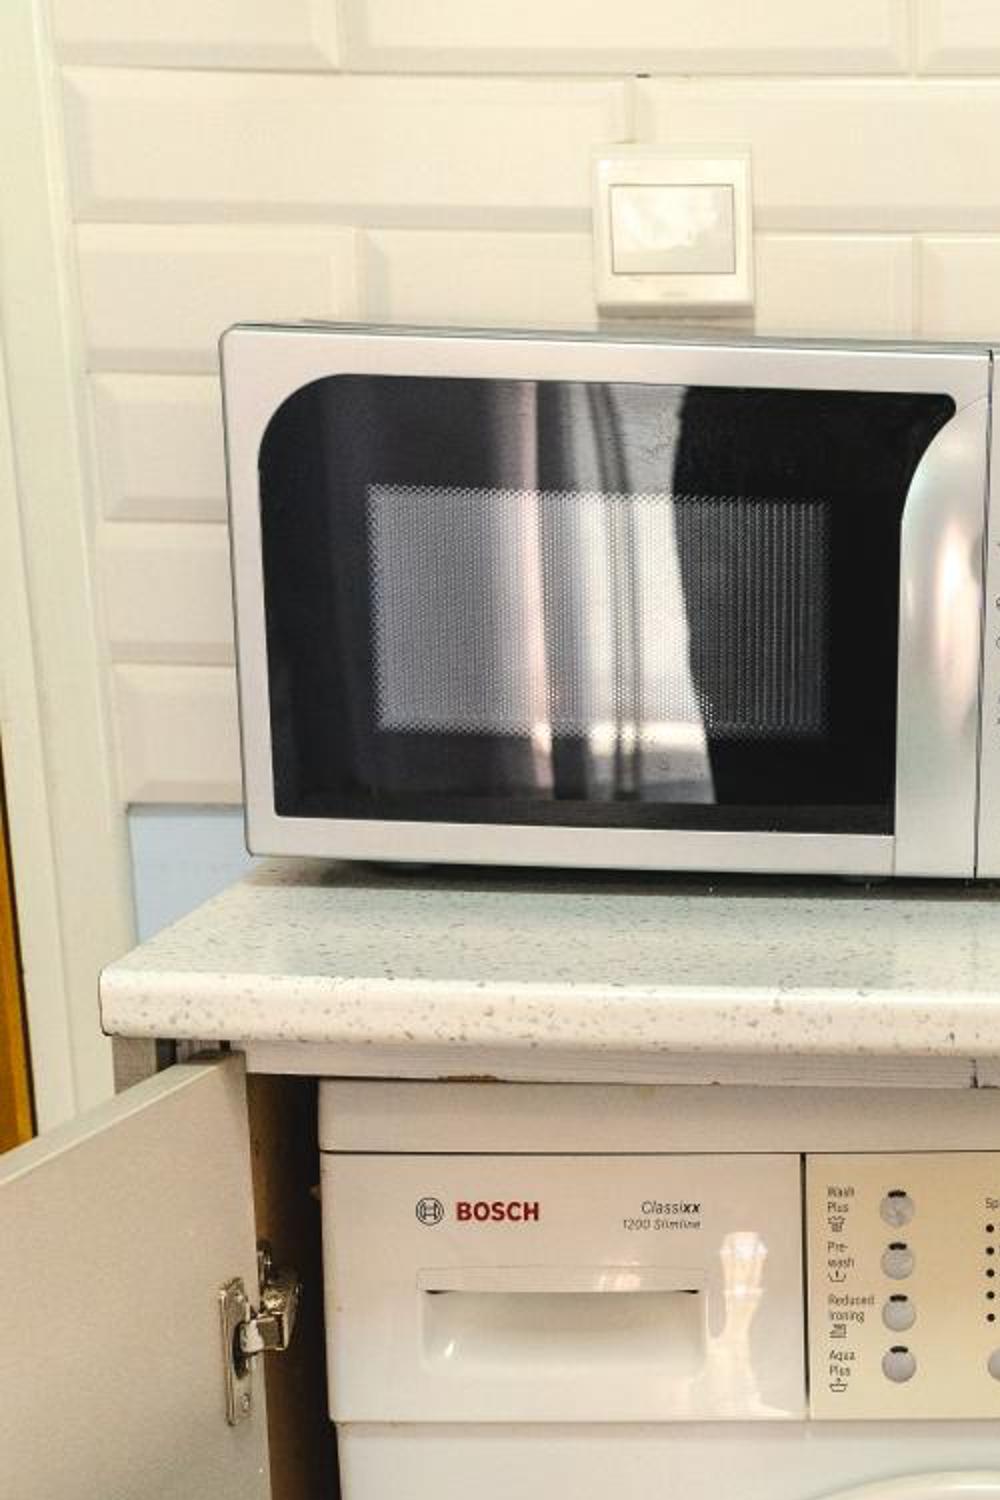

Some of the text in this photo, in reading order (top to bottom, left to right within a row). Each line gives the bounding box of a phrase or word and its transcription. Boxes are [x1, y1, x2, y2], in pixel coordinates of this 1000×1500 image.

[827, 1186, 855, 1198] Wash
[456, 1201, 540, 1221] BOSCH
[641, 1200, 701, 1215] Classixx
[827, 1202, 849, 1213] Plus
[623, 1218, 701, 1230] 1200 Slimline
[827, 1293, 875, 1305] Reduced
[828, 1310, 865, 1324] Ironing
[828, 1350, 856, 1362] Aqua
[828, 1365, 851, 1377] Plus
